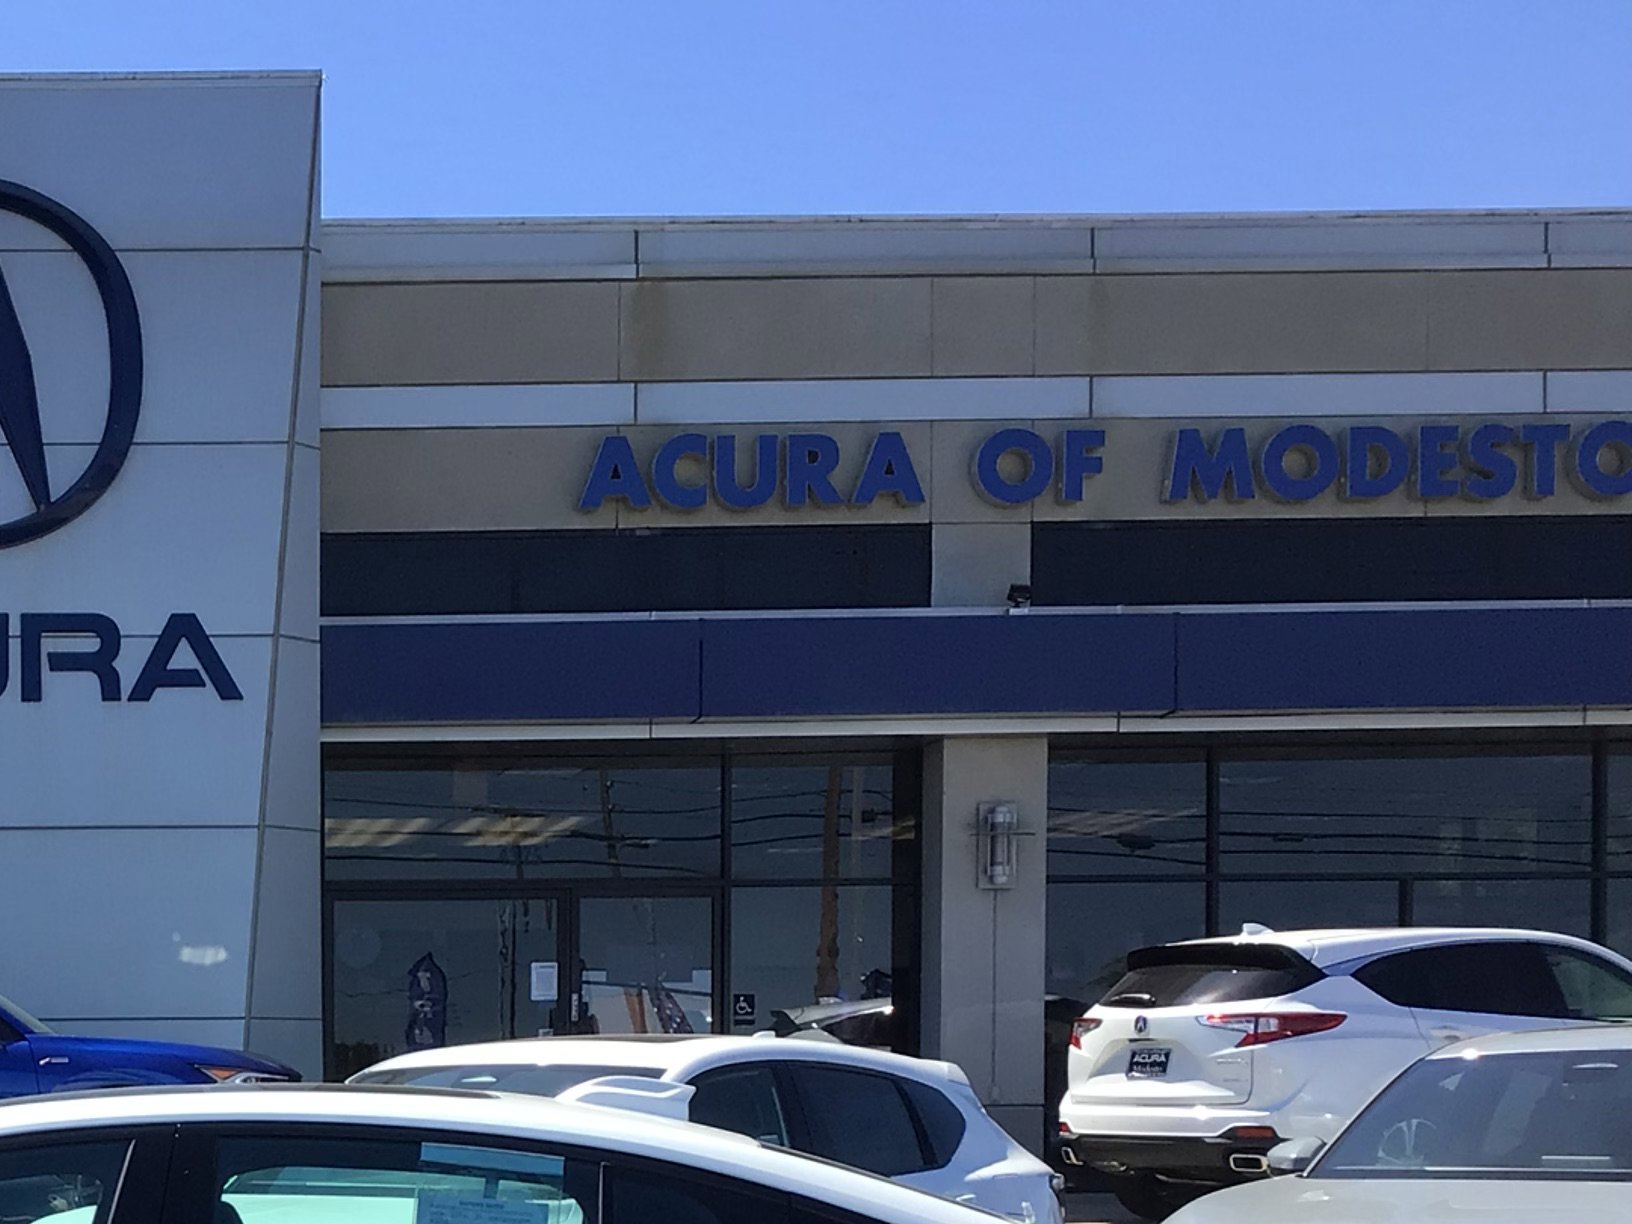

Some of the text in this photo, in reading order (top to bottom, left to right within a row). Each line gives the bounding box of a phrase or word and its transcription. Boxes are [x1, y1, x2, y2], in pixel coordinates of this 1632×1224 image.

[579, 420, 1632, 509] ACURA OF MODESTO
[1133, 1053, 1167, 1063] ACURA
